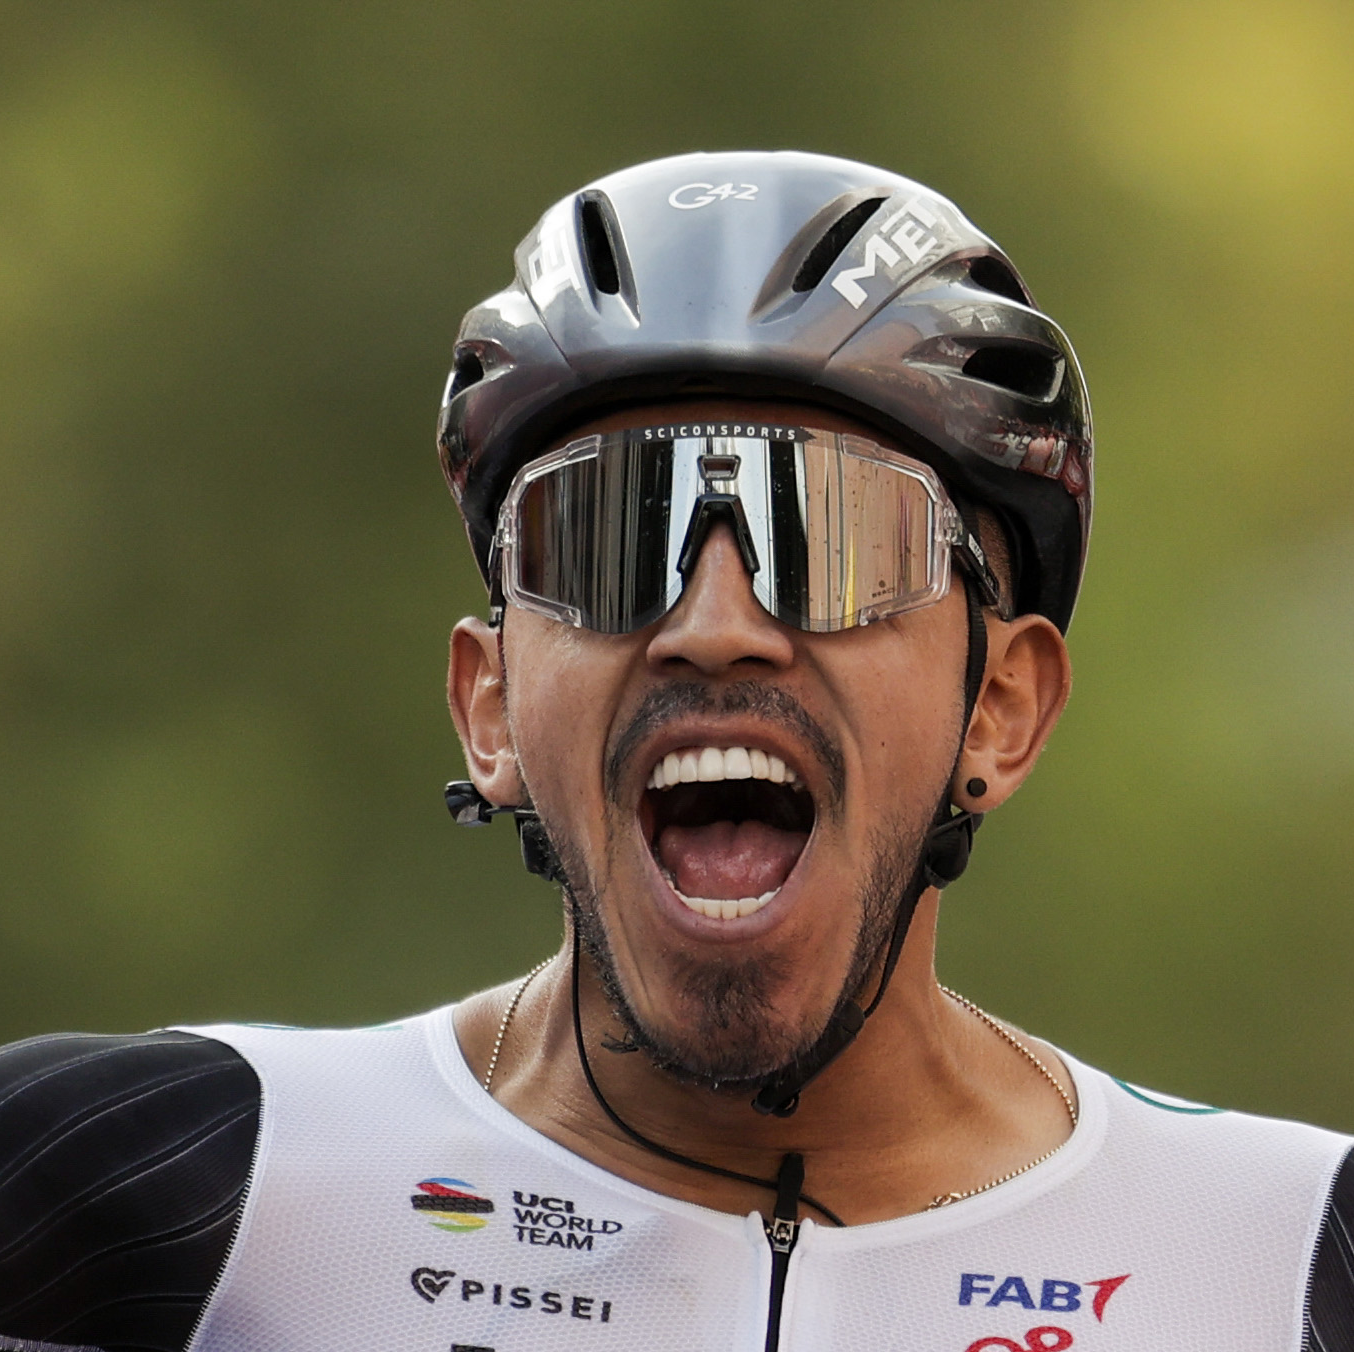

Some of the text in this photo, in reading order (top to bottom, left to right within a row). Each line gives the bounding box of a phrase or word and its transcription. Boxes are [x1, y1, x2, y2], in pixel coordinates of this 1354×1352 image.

[667, 182, 760, 210] G42
[830, 199, 939, 310] MET
[645, 425, 796, 440] SCICONSPORTS
[512, 1191, 575, 1214] UCI
[513, 1208, 623, 1235] WORLD
[513, 1225, 594, 1251] TEAM
[461, 1278, 613, 1323] PISSEI
[958, 1273, 1082, 1312] FAB
